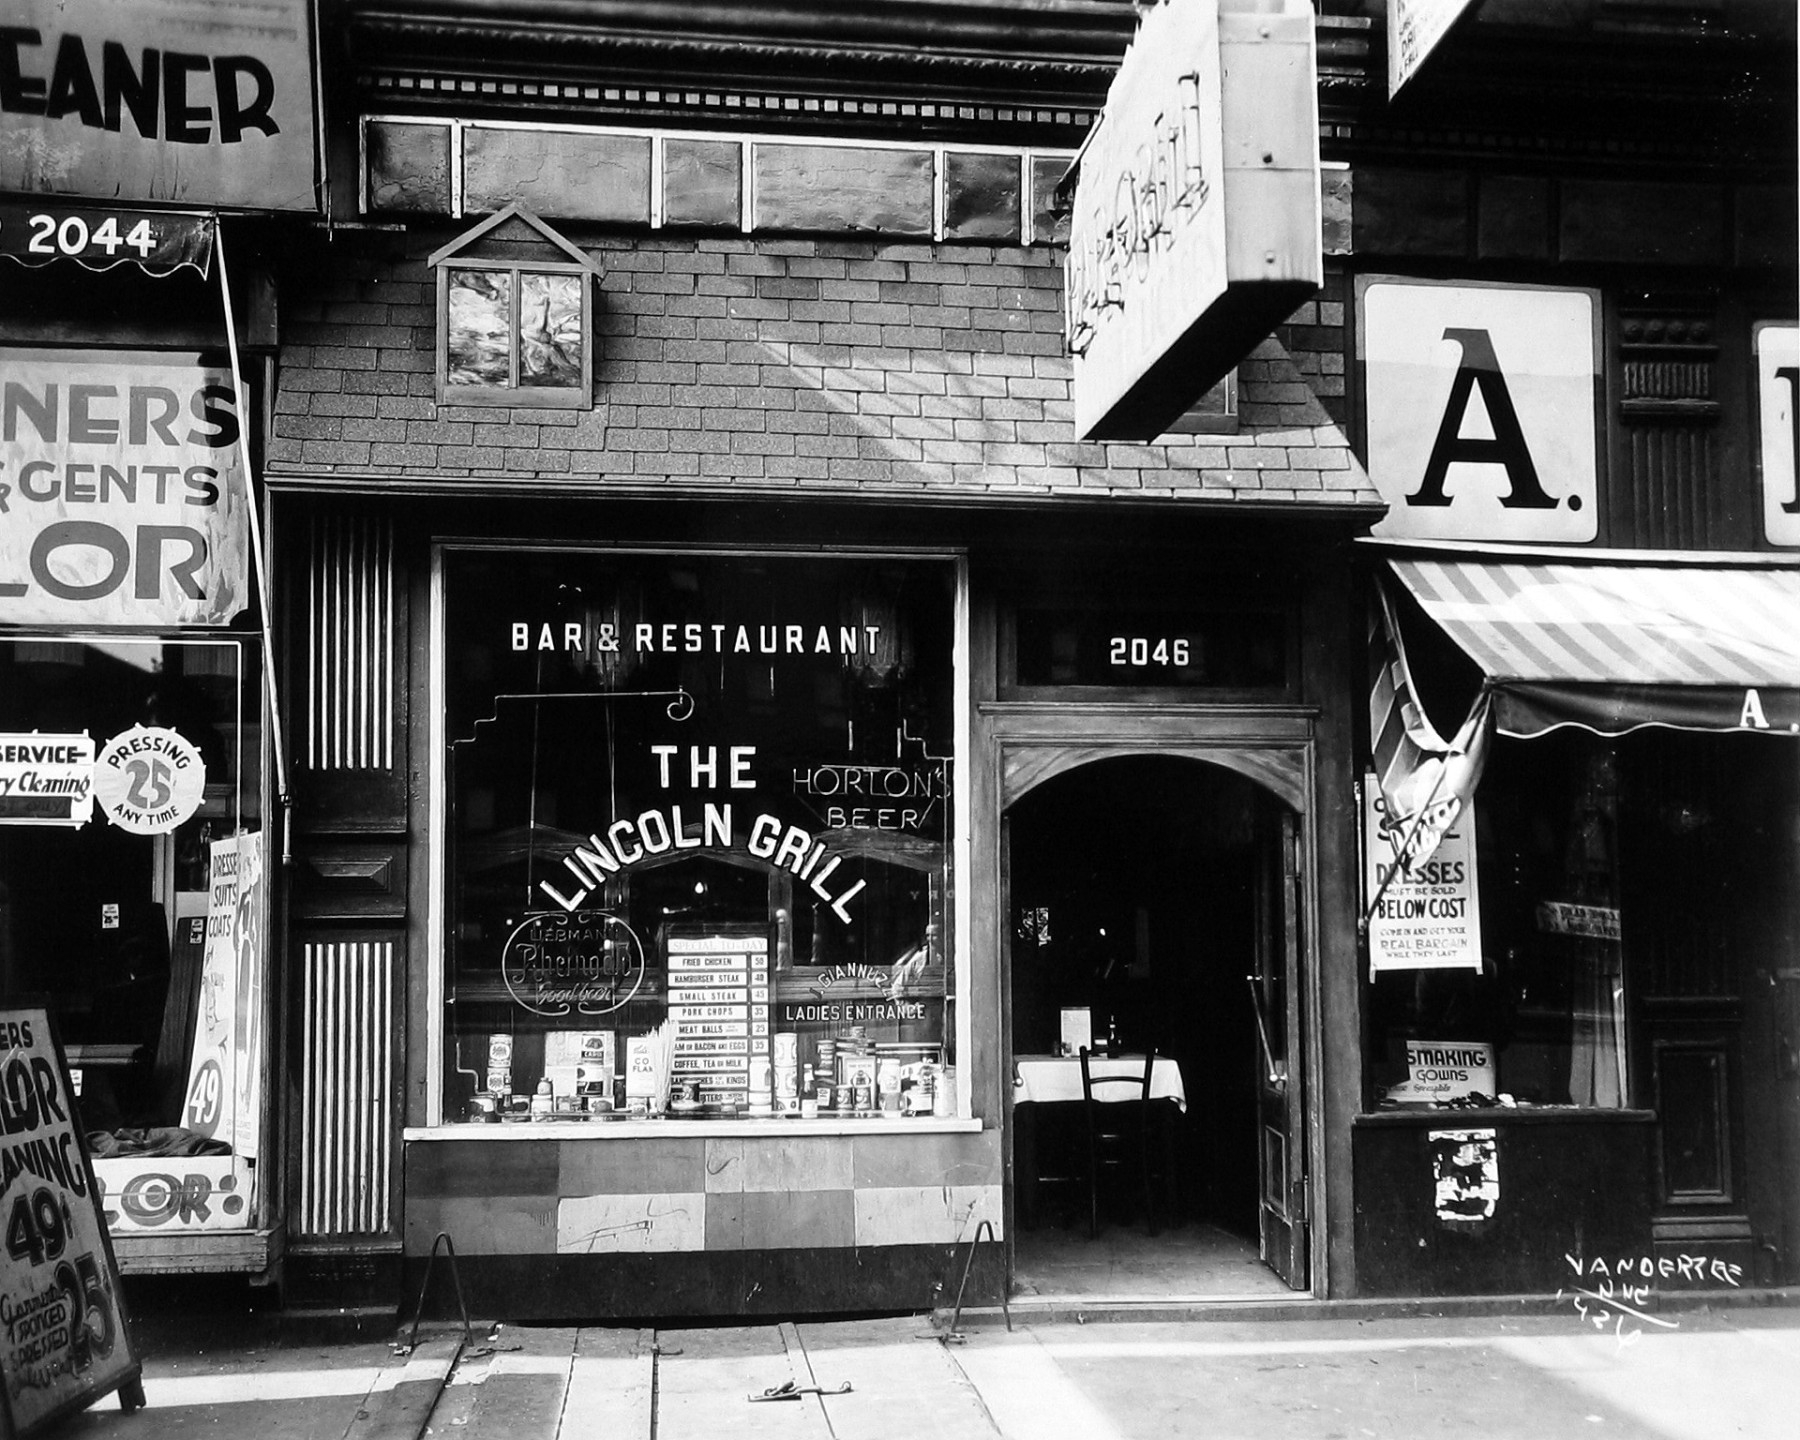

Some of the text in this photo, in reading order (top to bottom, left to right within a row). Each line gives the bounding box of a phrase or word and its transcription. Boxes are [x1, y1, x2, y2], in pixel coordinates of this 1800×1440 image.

[28, 214, 157, 257] 2044
[3, 382, 240, 448] NERS
[1404, 326, 1583, 512] A.
[19, 461, 219, 506] GENTS
[511, 622, 880, 655] BAR & RESTAURANT
[1110, 637, 1190, 666] 2046
[107, 736, 191, 769] PRESSING
[651, 745, 757, 790] THE
[19, 771, 90, 803] Cleaning
[125, 758, 172, 809] 25
[793, 767, 951, 799] HORTON'S
[113, 803, 180, 826] ANY TIME
[827, 807, 918, 830] BEER
[539, 803, 867, 925] LINCOLN GRILL
[214, 884, 237, 907] SUITS
[1431, 886, 1456, 895] SOLD
[1378, 898, 1467, 919] BELOW COST
[209, 914, 231, 938] COATS
[673, 941, 717, 951] SPECIAL
[1380, 940, 1412, 950] REAL
[682, 958, 701, 966] FRIED
[704, 957, 732, 966] CHICKEN
[718, 975, 739, 983] STEAK
[679, 993, 706, 1001] SMALL
[711, 992, 737, 1000] STEAK
[707, 1007, 733, 1016] CHOPS
[754, 1008, 764, 1016] 35
[786, 1004, 925, 1020] LADIES ENTRANCE
[679, 1025, 698, 1034] MEAT
[702, 1025, 723, 1033] BALLS
[703, 1060, 715, 1068] TEA
[190, 1069, 219, 1124] 49
[0, 1132, 86, 1198] ANING
